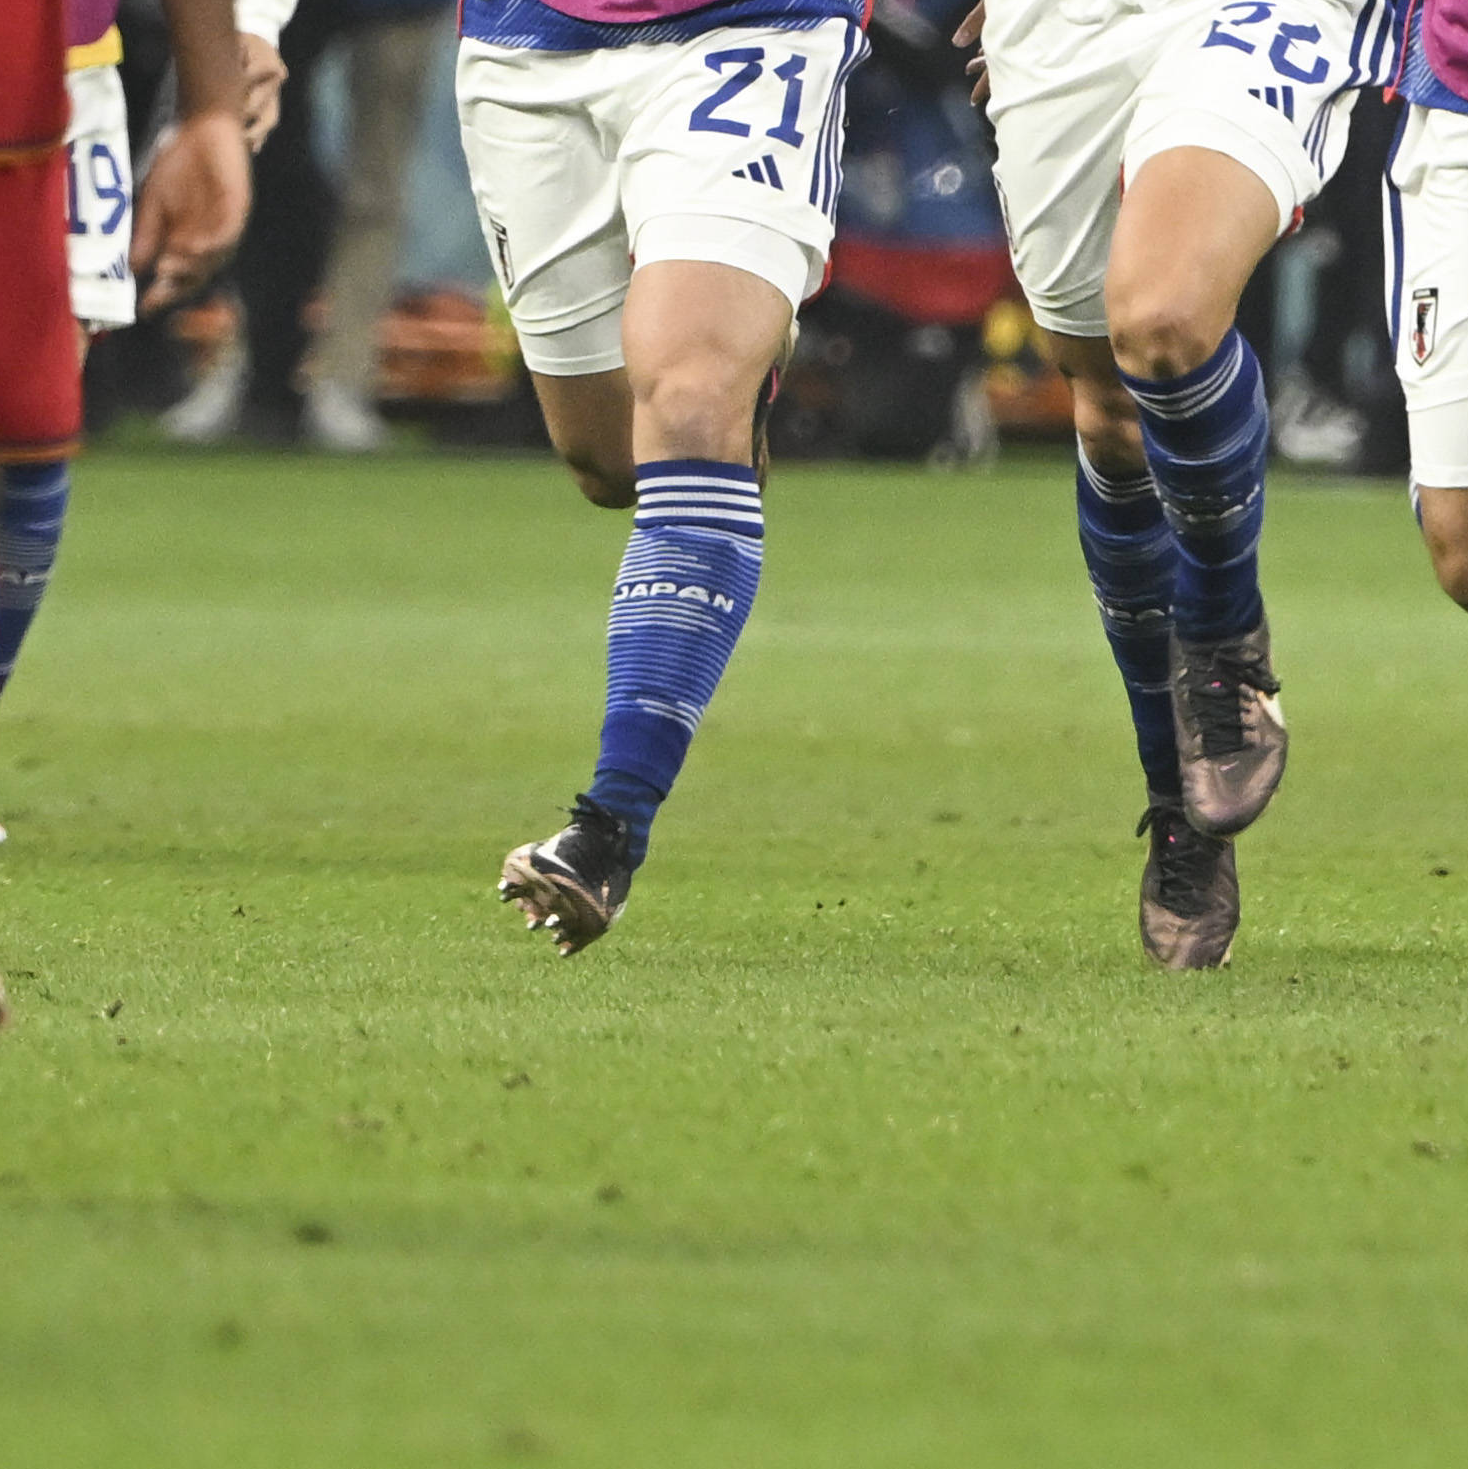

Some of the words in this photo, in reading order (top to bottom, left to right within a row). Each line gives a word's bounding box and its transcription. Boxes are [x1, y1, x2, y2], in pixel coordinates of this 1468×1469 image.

[688, 45, 807, 149] 21
[66, 139, 128, 235] 19
[612, 582, 736, 614] JAPAN
